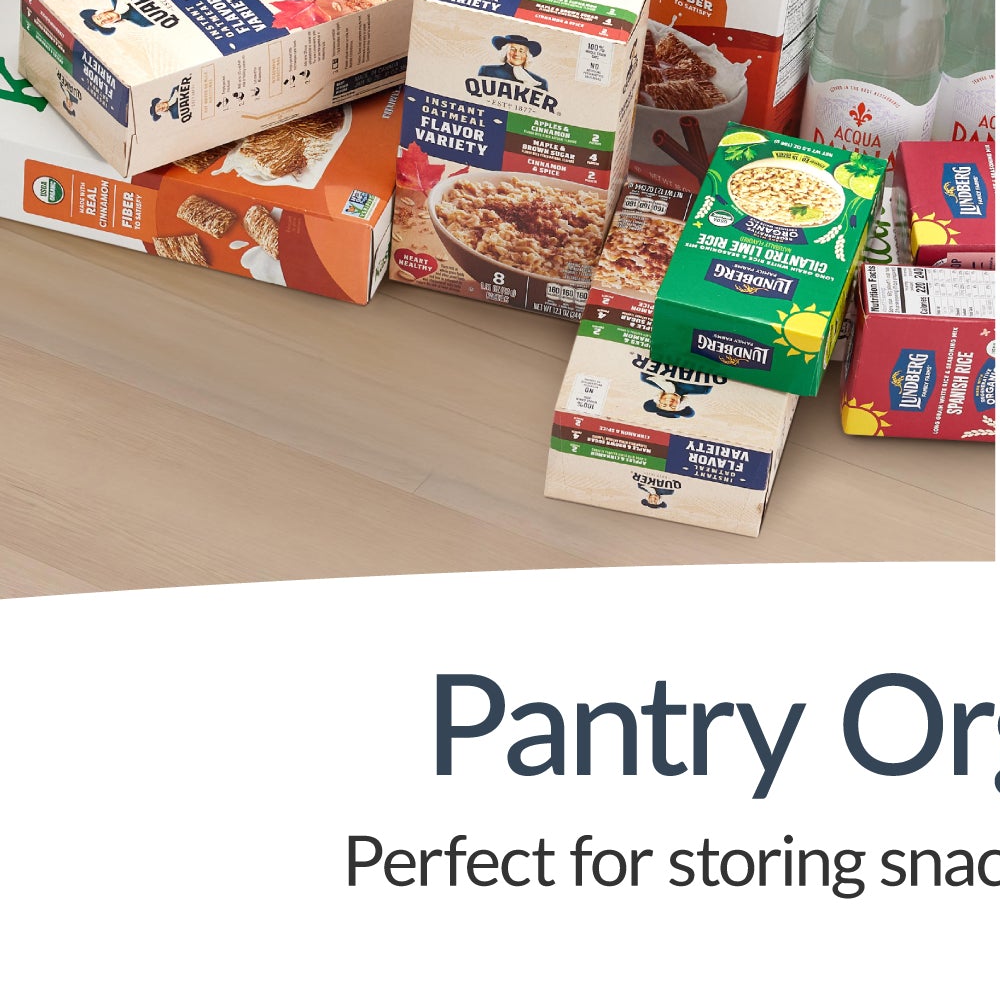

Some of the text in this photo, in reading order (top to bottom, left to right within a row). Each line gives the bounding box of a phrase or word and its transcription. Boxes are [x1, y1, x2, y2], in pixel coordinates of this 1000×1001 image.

[198, 0, 235, 38] OATMEAL
[684, 3, 712, 18] SATISFY
[186, 5, 223, 40] INSTANT
[82, 51, 116, 90] VARIETY
[83, 64, 114, 99] FLAVOR
[180, 76, 192, 124] QUAKER
[465, 77, 559, 115] QUAKER
[422, 105, 486, 128] OATMEAL
[425, 96, 486, 117] INSTANT
[421, 116, 485, 142] FLAVOR
[530, 125, 571, 139] CINNAMON
[533, 119, 562, 131] APPLES
[415, 127, 489, 157] VARIETY
[532, 139, 559, 151] MAPLE
[591, 133, 600, 143] 2
[834, 125, 881, 148] ACQUA
[522, 142, 576, 160] BROWN SUGAR
[589, 153, 597, 162] 4
[527, 158, 567, 171] CINNAMON
[538, 166, 560, 177] SPICE
[588, 171, 596, 180] 2
[952, 166, 982, 216] LUNDBERG
[86, 187, 98, 216] REAL
[99, 180, 110, 228] CINNAMON
[121, 192, 134, 229] FIBER
[745, 219, 799, 239] ORGANIC
[403, 253, 429, 265] HEART
[696, 233, 829, 275] CILANTRO LIME RICE
[700, 244, 741, 258] SEASONING
[748, 255, 766, 265] RICE
[398, 260, 433, 273] HEALTHY
[766, 260, 789, 271] WHITE
[790, 266, 813, 278] GRAIN
[493, 272, 505, 286] 8
[714, 263, 794, 295] LUNDBERG
[815, 271, 835, 281] LONG
[870, 283, 879, 312] Nutrition
[697, 333, 770, 365] LUNDBERG
[899, 353, 929, 409] LUNDBERG
[946, 351, 975, 415] SPANISH RICE
[685, 440, 750, 462] VARIETY
[688, 452, 744, 472] FLAVOR
[693, 464, 737, 478] OATMEAL
[632, 472, 682, 489] QUAKER
[694, 471, 733, 482] INSTANT
